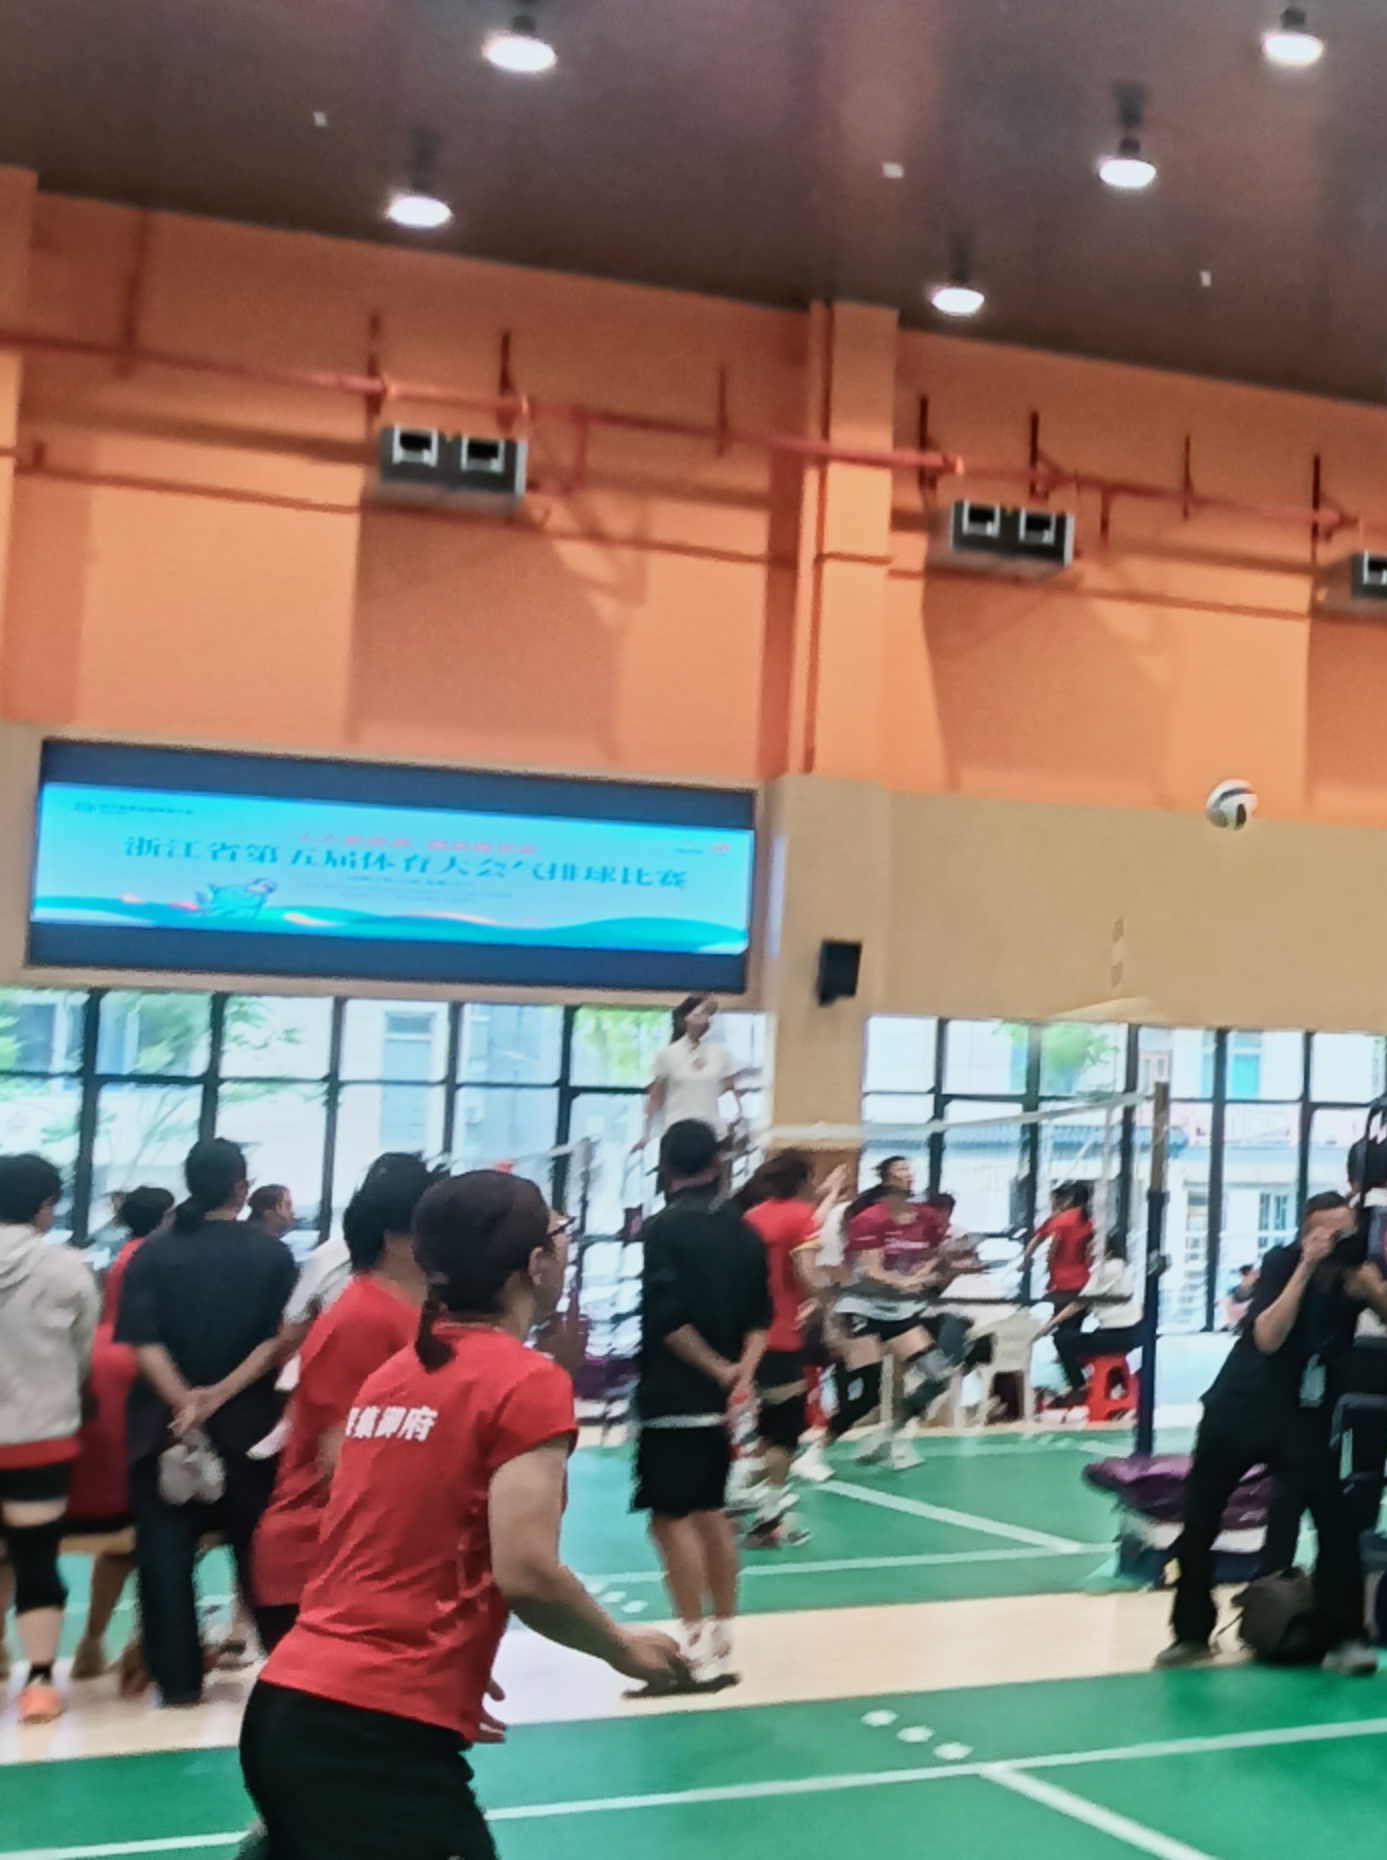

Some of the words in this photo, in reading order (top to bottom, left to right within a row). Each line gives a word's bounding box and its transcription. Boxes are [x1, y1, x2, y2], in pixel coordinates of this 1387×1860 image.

[125, 835, 688, 888] 浙江省第五届体育大会气排球比赛
